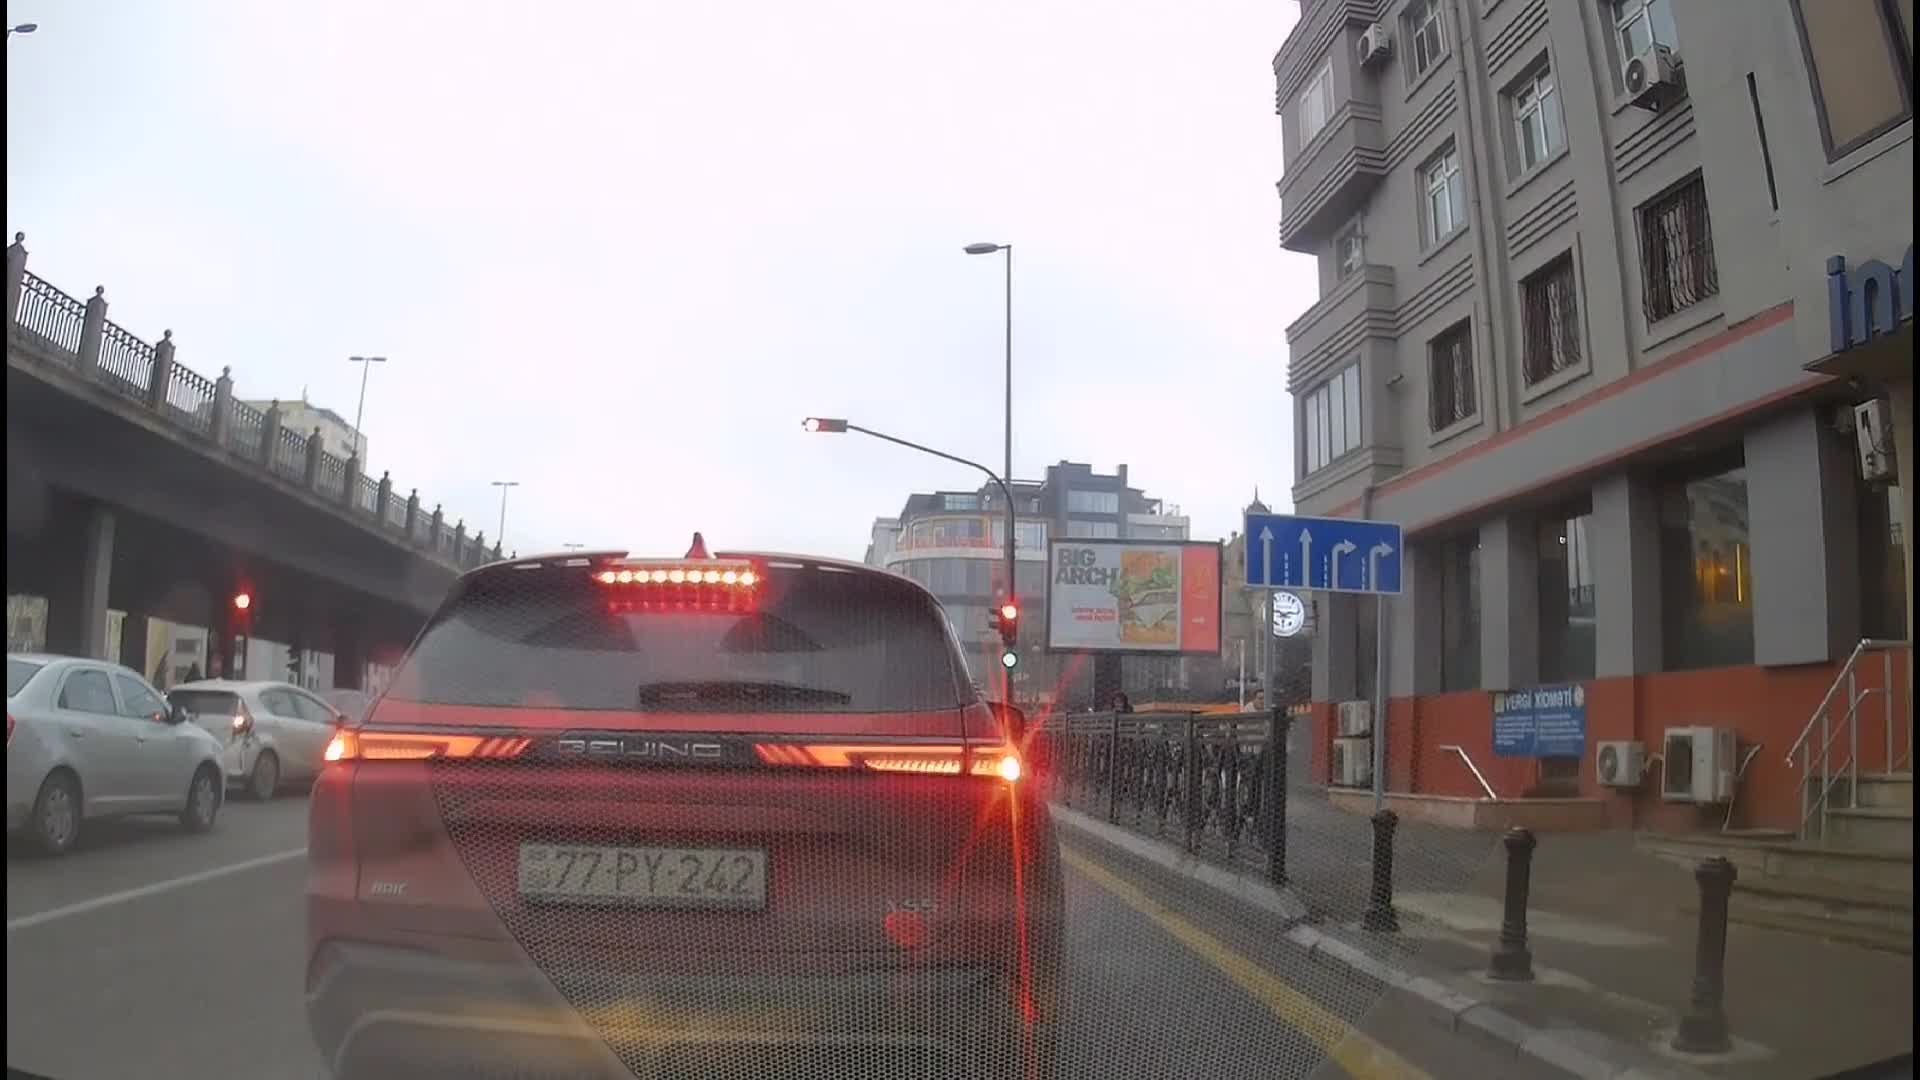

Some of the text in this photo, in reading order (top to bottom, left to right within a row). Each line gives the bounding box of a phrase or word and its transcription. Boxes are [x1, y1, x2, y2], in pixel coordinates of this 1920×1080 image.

[1057, 549, 1097, 567] BIG
[1055, 567, 1119, 585] ARCH
[559, 740, 721, 757] BEIJING
